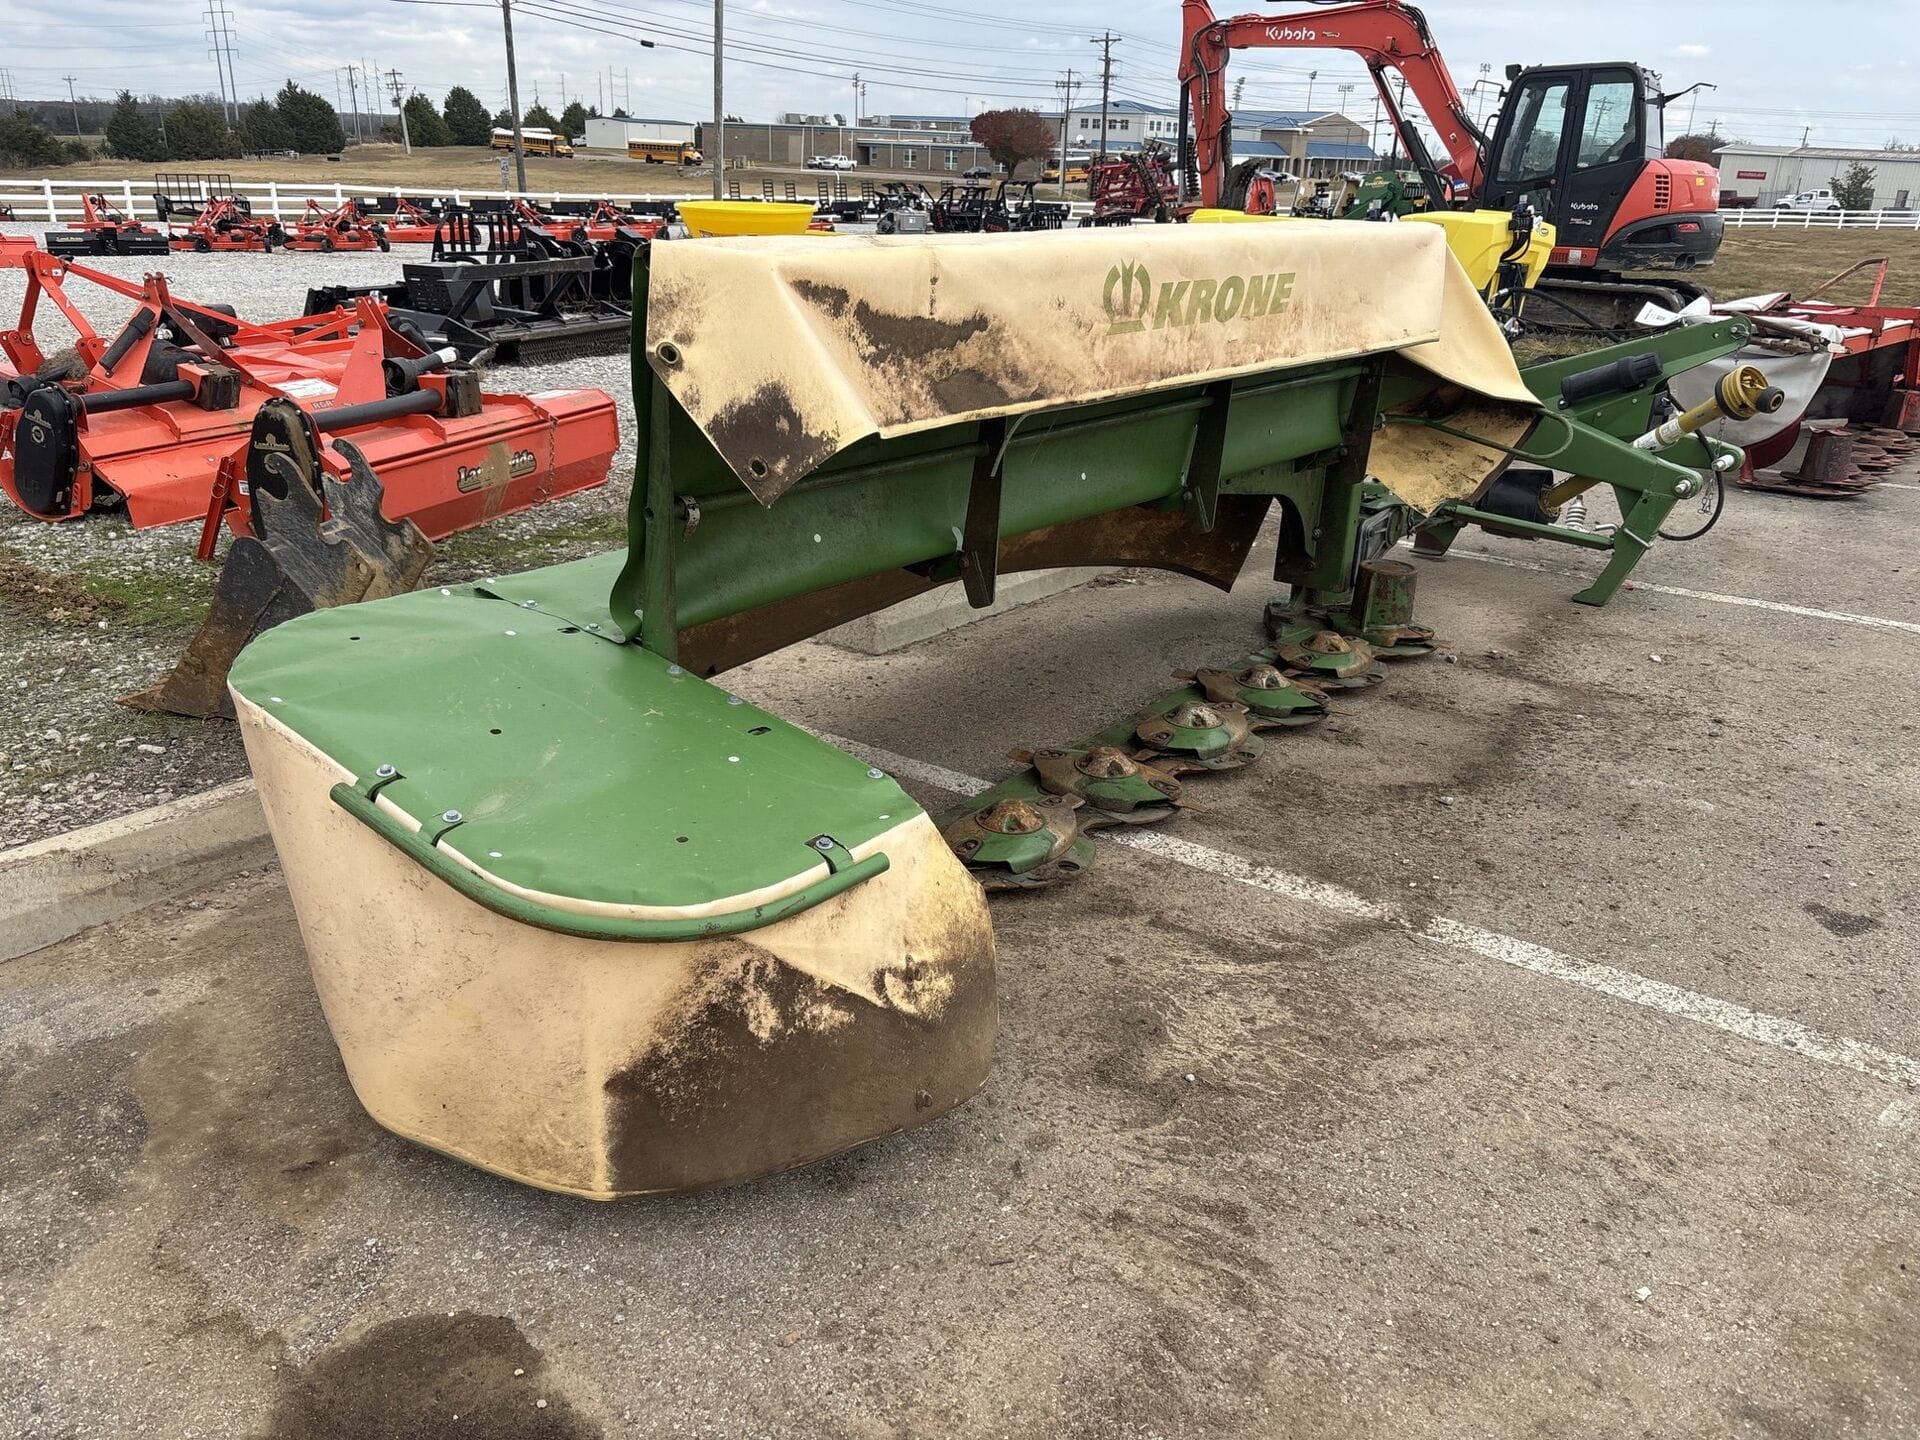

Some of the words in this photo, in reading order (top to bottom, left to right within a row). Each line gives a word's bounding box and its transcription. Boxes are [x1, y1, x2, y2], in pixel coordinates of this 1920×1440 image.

[1265, 26, 1316, 41] Kubota
[1570, 202, 1599, 210] Kubota
[1152, 272, 1296, 330] KRONE
